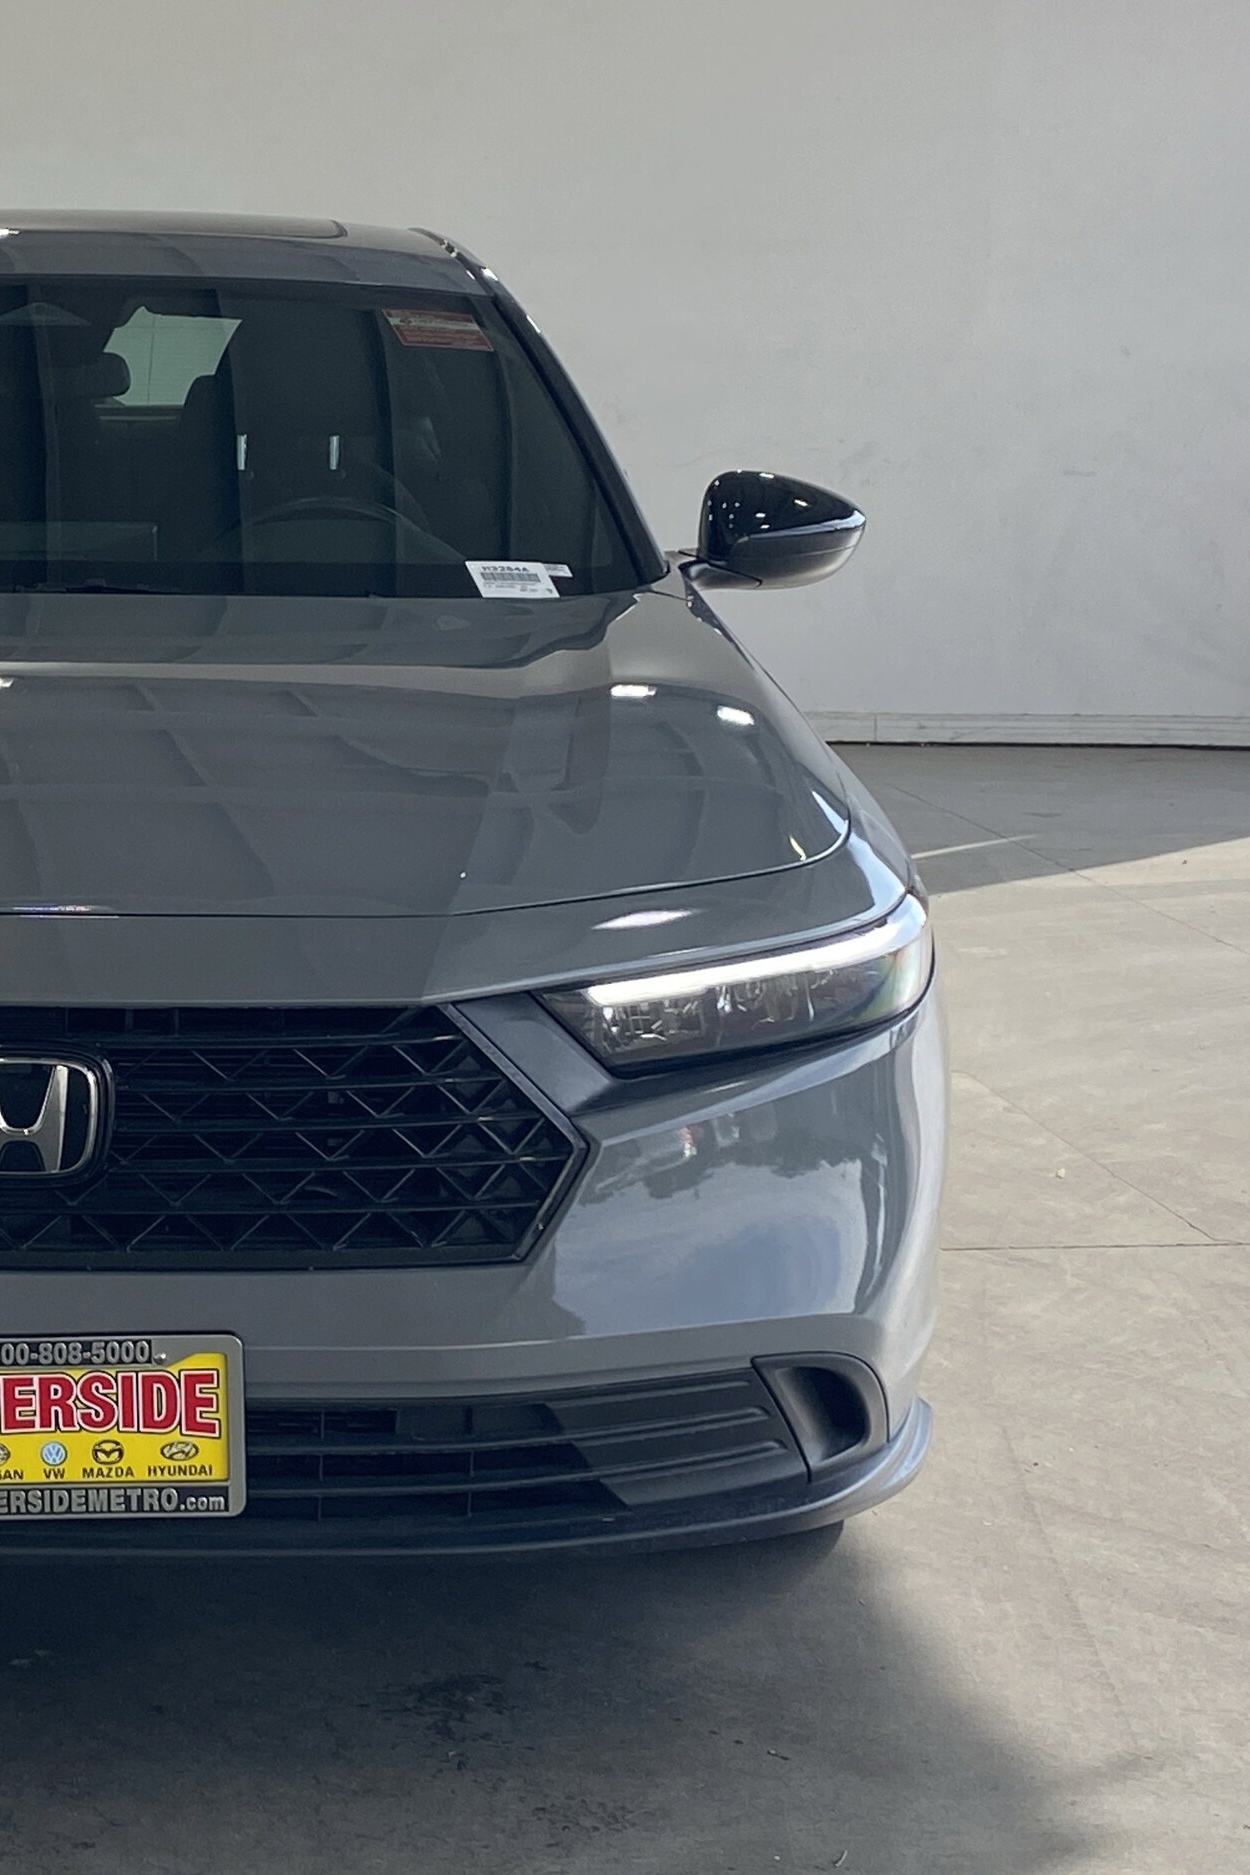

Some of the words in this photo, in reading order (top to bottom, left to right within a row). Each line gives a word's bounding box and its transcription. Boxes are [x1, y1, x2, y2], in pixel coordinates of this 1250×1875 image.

[43, 1468, 67, 1480] VW
[82, 1466, 135, 1479] MAZDA
[147, 1464, 213, 1478] HYUNDAI
